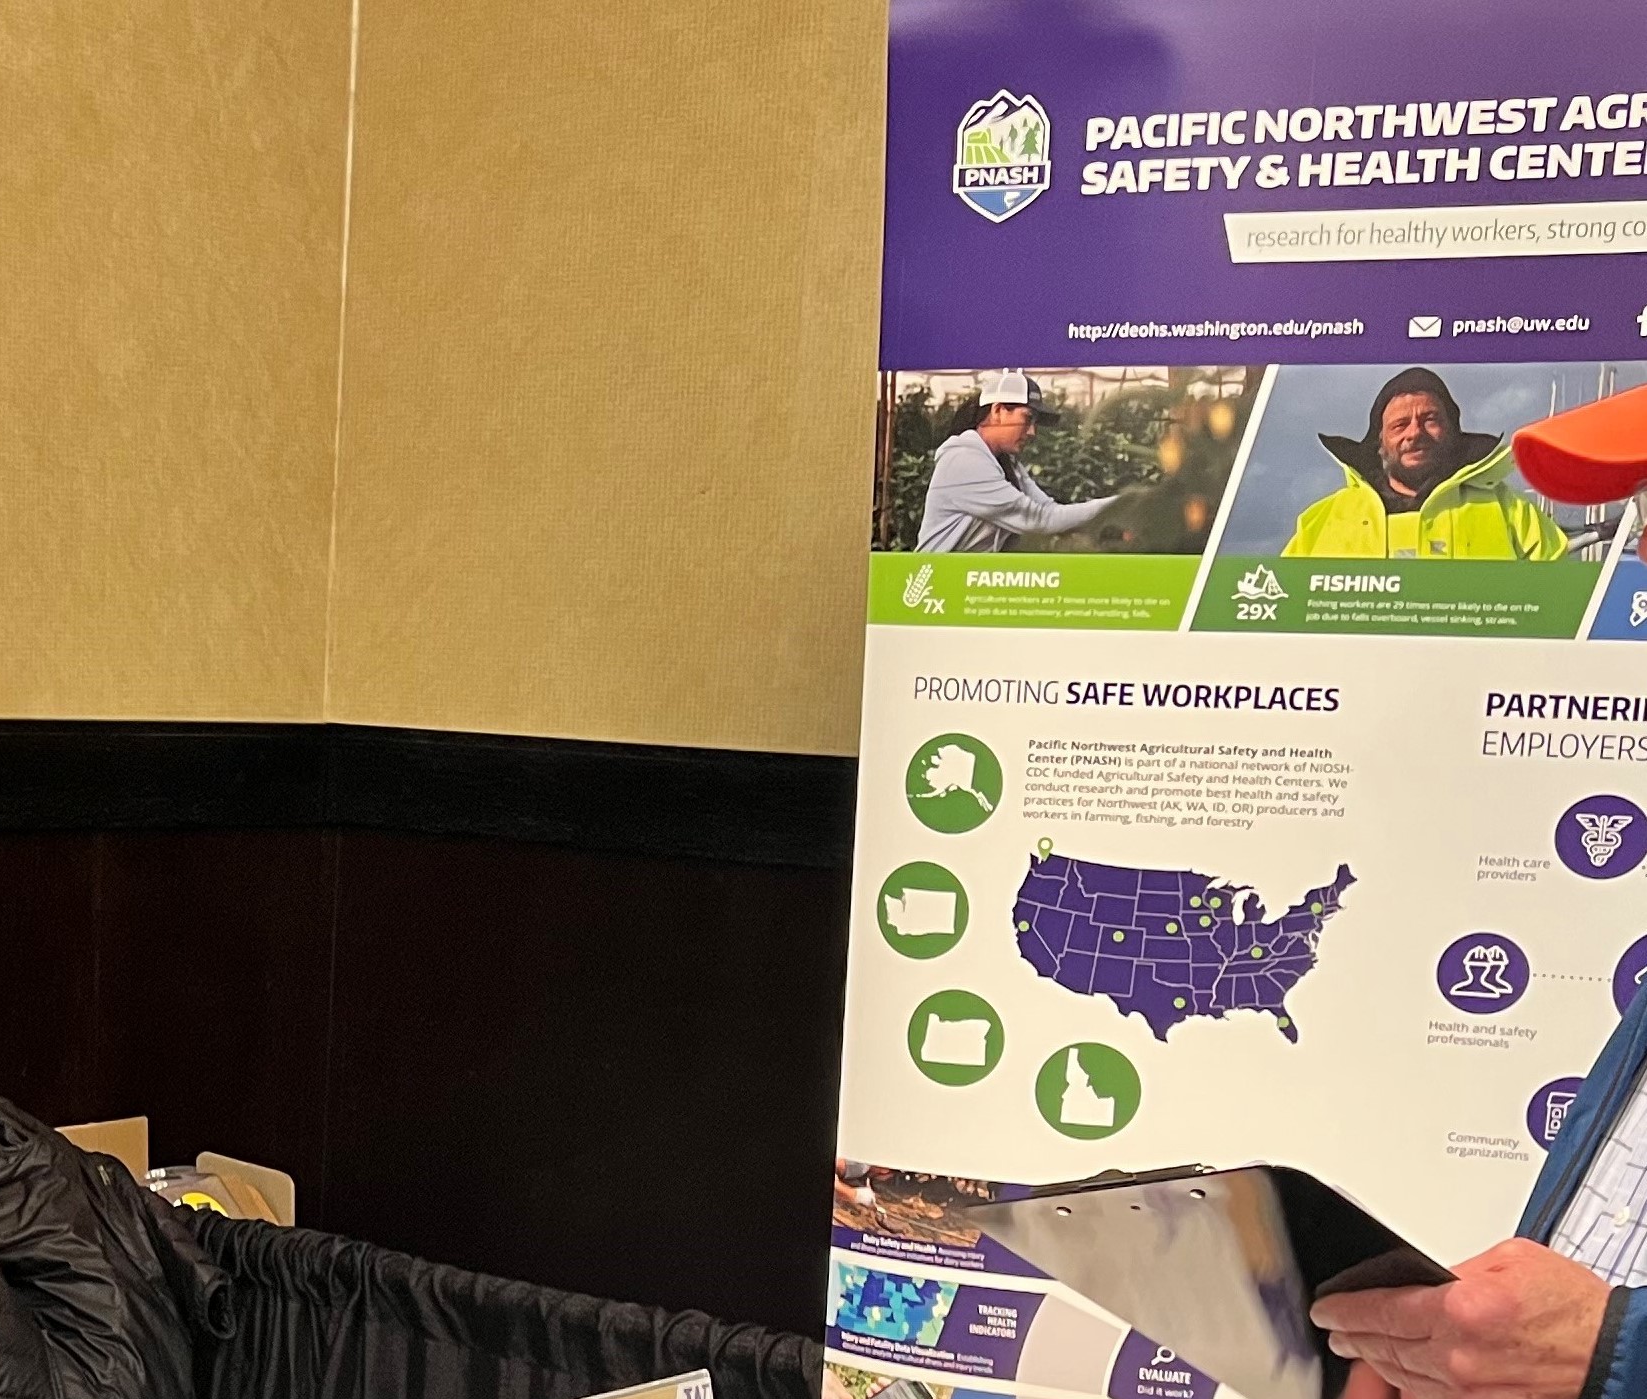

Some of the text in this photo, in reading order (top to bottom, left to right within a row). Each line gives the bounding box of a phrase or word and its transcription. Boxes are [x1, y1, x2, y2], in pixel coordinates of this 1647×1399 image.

[1085, 110, 1247, 151] PACIFIC
[1255, 97, 1558, 143] NORTHWEST
[965, 167, 1039, 186] PNASH
[1081, 141, 1647, 195] SAFETY & HEALTH CENTE
[1247, 223, 1331, 248] research
[1337, 222, 1365, 245] for
[1370, 221, 1449, 248] healthy
[1452, 219, 1541, 244] workers,
[1547, 219, 1617, 244] strong
[1067, 317, 1364, 342] http://deohs.washington.edu/pnash
[1452, 313, 1590, 337] pnash@uw.edu
[966, 570, 1060, 588] FARMING
[1309, 574, 1401, 593] FISHING
[923, 598, 946, 615] 7X
[1236, 603, 1277, 621] 29X
[914, 676, 1339, 712] PROMOTING SAFE WORKPLACES
[1028, 739, 1333, 759] Pacific Northwest Agricultural Safety and Health
[1482, 730, 1647, 762] EMPLOYERS
[1027, 752, 1354, 774] Center (PNASH) is part of a national network of NIOSH-
[1025, 766, 1050, 778] CDC
[1052, 767, 1094, 780] funded
[1096, 769, 1164, 782] Agricultural
[1166, 771, 1204, 785] Safety
[1205, 774, 1230, 784] and
[1231, 774, 1272, 786] Health
[1327, 777, 1348, 789] We
[1024, 781, 1340, 805] conduct research and promote best health and safety
[1023, 796, 1074, 807] practices
[1076, 796, 1094, 808] for
[1096, 797, 1158, 810] Northwest
[1231, 802, 1254, 815] OR)
[1255, 804, 1318, 817] producers
[1320, 806, 1345, 818] and
[1022, 809, 1068, 820] workers
[1070, 810, 1082, 821] in
[1180, 815, 1204, 826] and
[1206, 815, 1254, 831] forestry
[1478, 855, 1551, 869] Health care
[1477, 869, 1537, 881] providers
[1428, 1020, 1538, 1041] Health and safety
[1427, 1033, 1510, 1049] professionals
[1447, 1132, 1520, 1149] Community
[1446, 1144, 1529, 1162] organizations
[977, 1304, 1018, 1318] TRACKING
[987, 1314, 1017, 1328] HEALTH
[969, 1324, 1017, 1340] INDICATORS
[1138, 1367, 1192, 1385] EVALUATE
[1137, 1384, 1154, 1396] Did
[1165, 1388, 1195, 1399] work?
